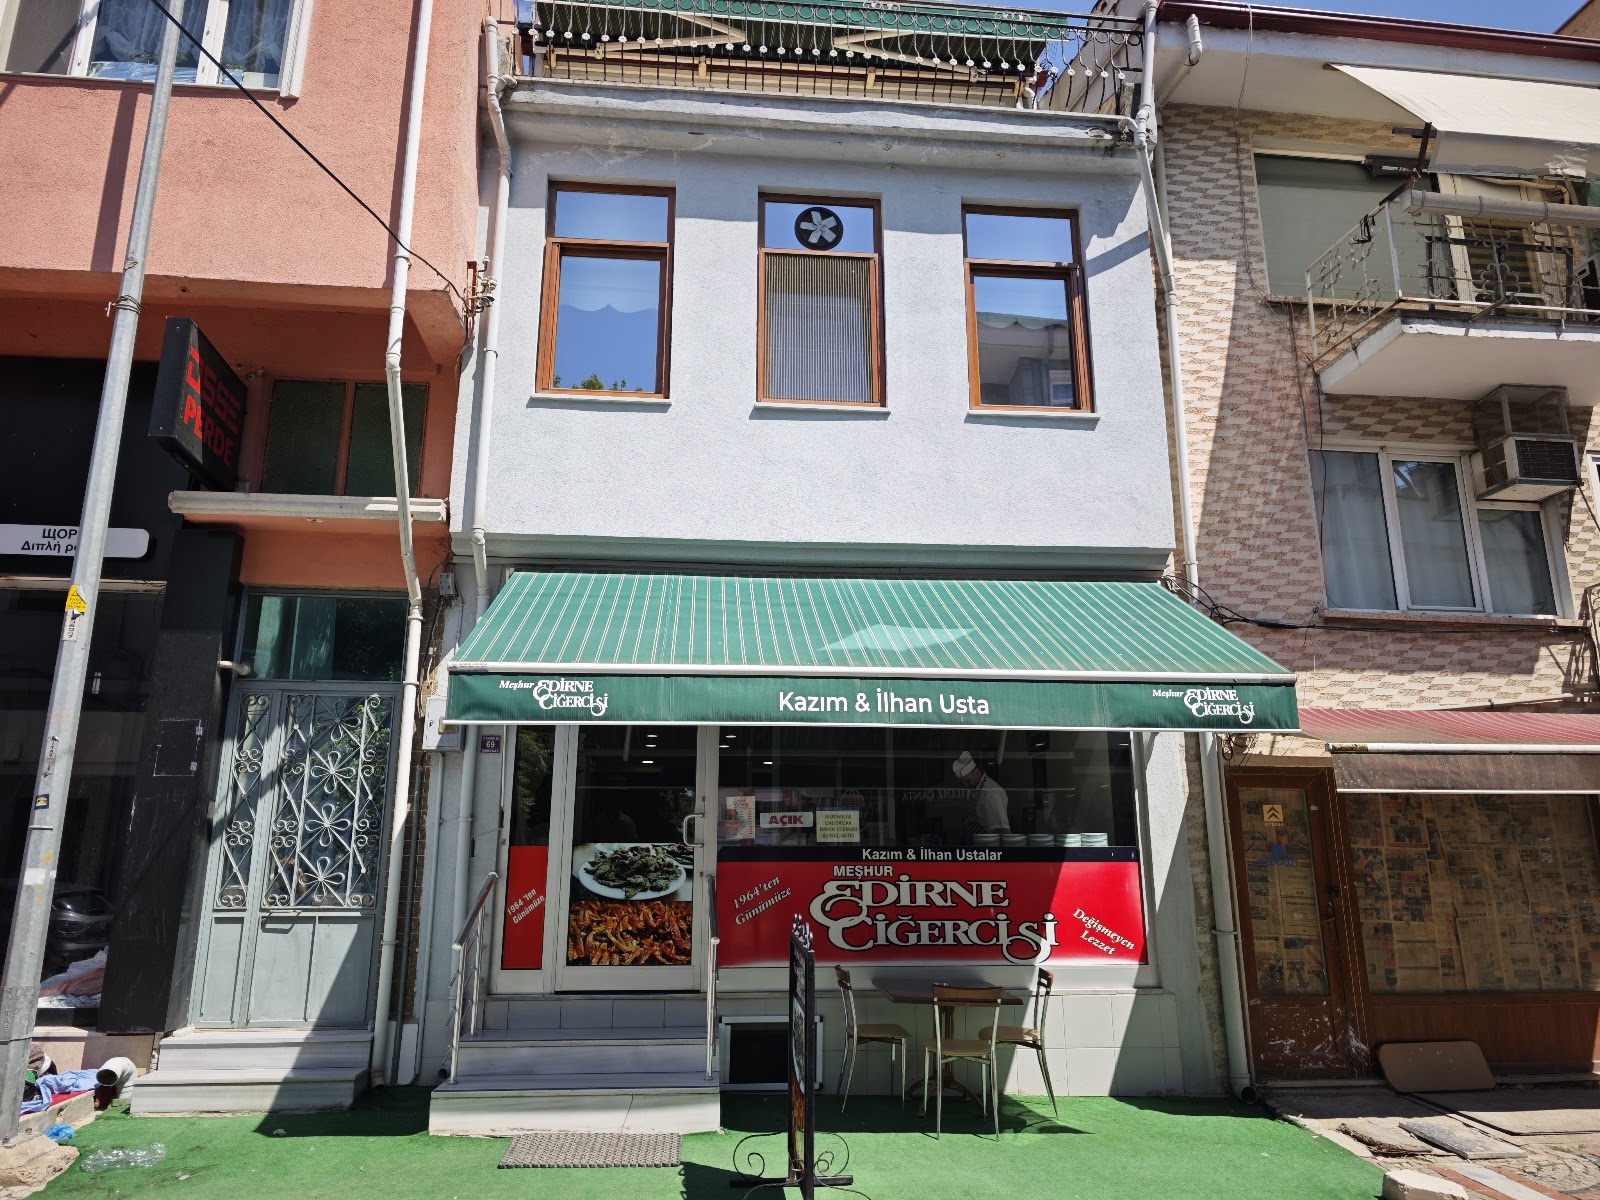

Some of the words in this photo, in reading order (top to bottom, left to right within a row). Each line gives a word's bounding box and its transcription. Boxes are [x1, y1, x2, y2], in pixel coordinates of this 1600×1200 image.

[183, 393, 233, 465] PERDE
[42, 528, 78, 540] ЩОР
[20, 540, 61, 554] Διπλή
[499, 680, 535, 690] Meşhur
[533, 678, 593, 701] EDİRNE
[779, 691, 848, 712] Kazım
[855, 692, 870, 712] &
[876, 687, 932, 713] İlhan
[939, 694, 989, 714] Usta
[1152, 689, 1184, 699] Meşhur
[1184, 687, 1239, 709] EDİRNE
[538, 692, 609, 716] CİĞERCİSİ
[1191, 701, 1255, 724] CİĞERCİSİ
[486, 740, 495, 748] 69
[768, 815, 804, 827] AÇIK
[862, 849, 902, 860] Kazım
[907, 849, 916, 860] &
[920, 847, 952, 861] İlhan
[956, 849, 1002, 861] Ustalar
[833, 866, 894, 879] MEŞHUR
[733, 876, 780, 909] 1964'ten
[809, 874, 1009, 928] EDİRNE
[507, 899, 524, 916] 1964
[512, 895, 545, 924] Günümüze
[735, 887, 792, 925] Günümüze
[827, 912, 1060, 965] CİĞERCİSİ
[1072, 908, 1135, 950] Değişmeyen
[1080, 930, 1116, 955] Lezzet
